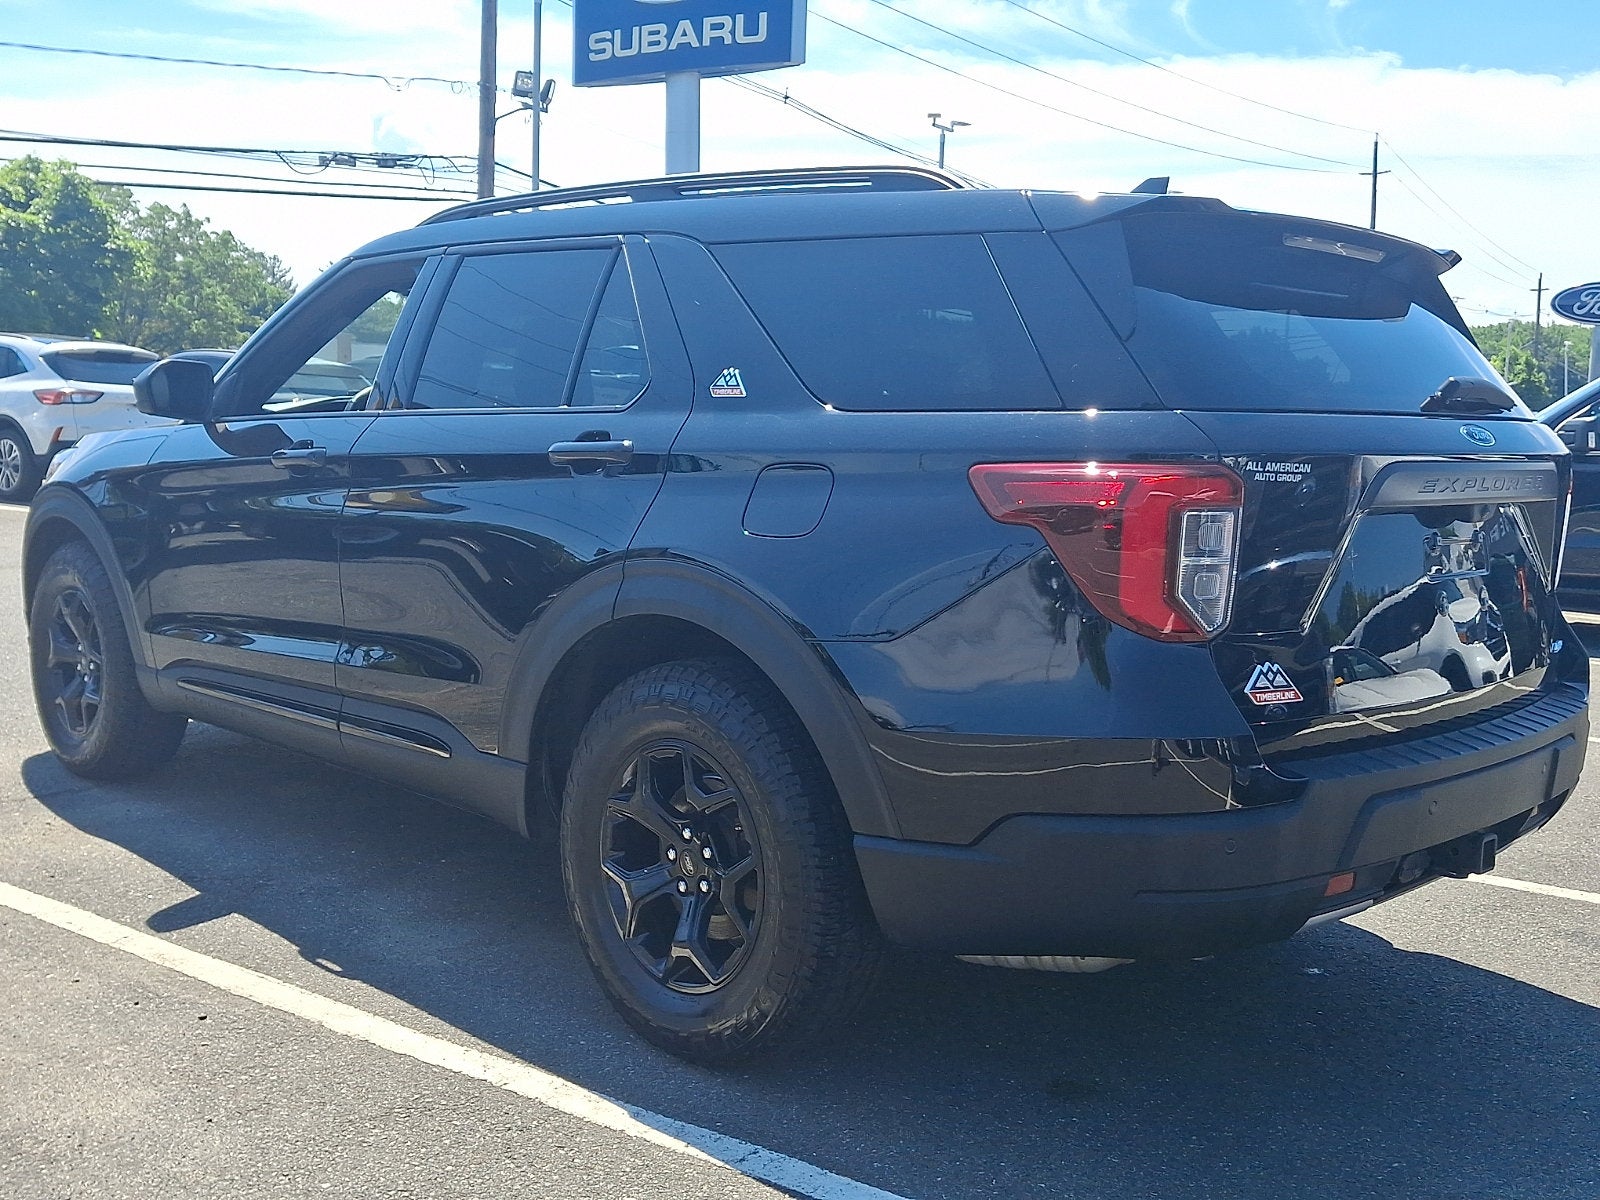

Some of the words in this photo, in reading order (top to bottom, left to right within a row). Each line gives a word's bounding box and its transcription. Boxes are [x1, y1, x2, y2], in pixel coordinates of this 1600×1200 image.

[588, 11, 768, 62] SUBARU
[1246, 461, 1264, 472] ALL
[1264, 462, 1312, 473] AMERICAN
[1254, 472, 1276, 482] AUTO
[1276, 473, 1302, 483] GROUP
[1418, 475, 1544, 494] EXPLORER
[1255, 691, 1296, 701] TIMBERLINE
